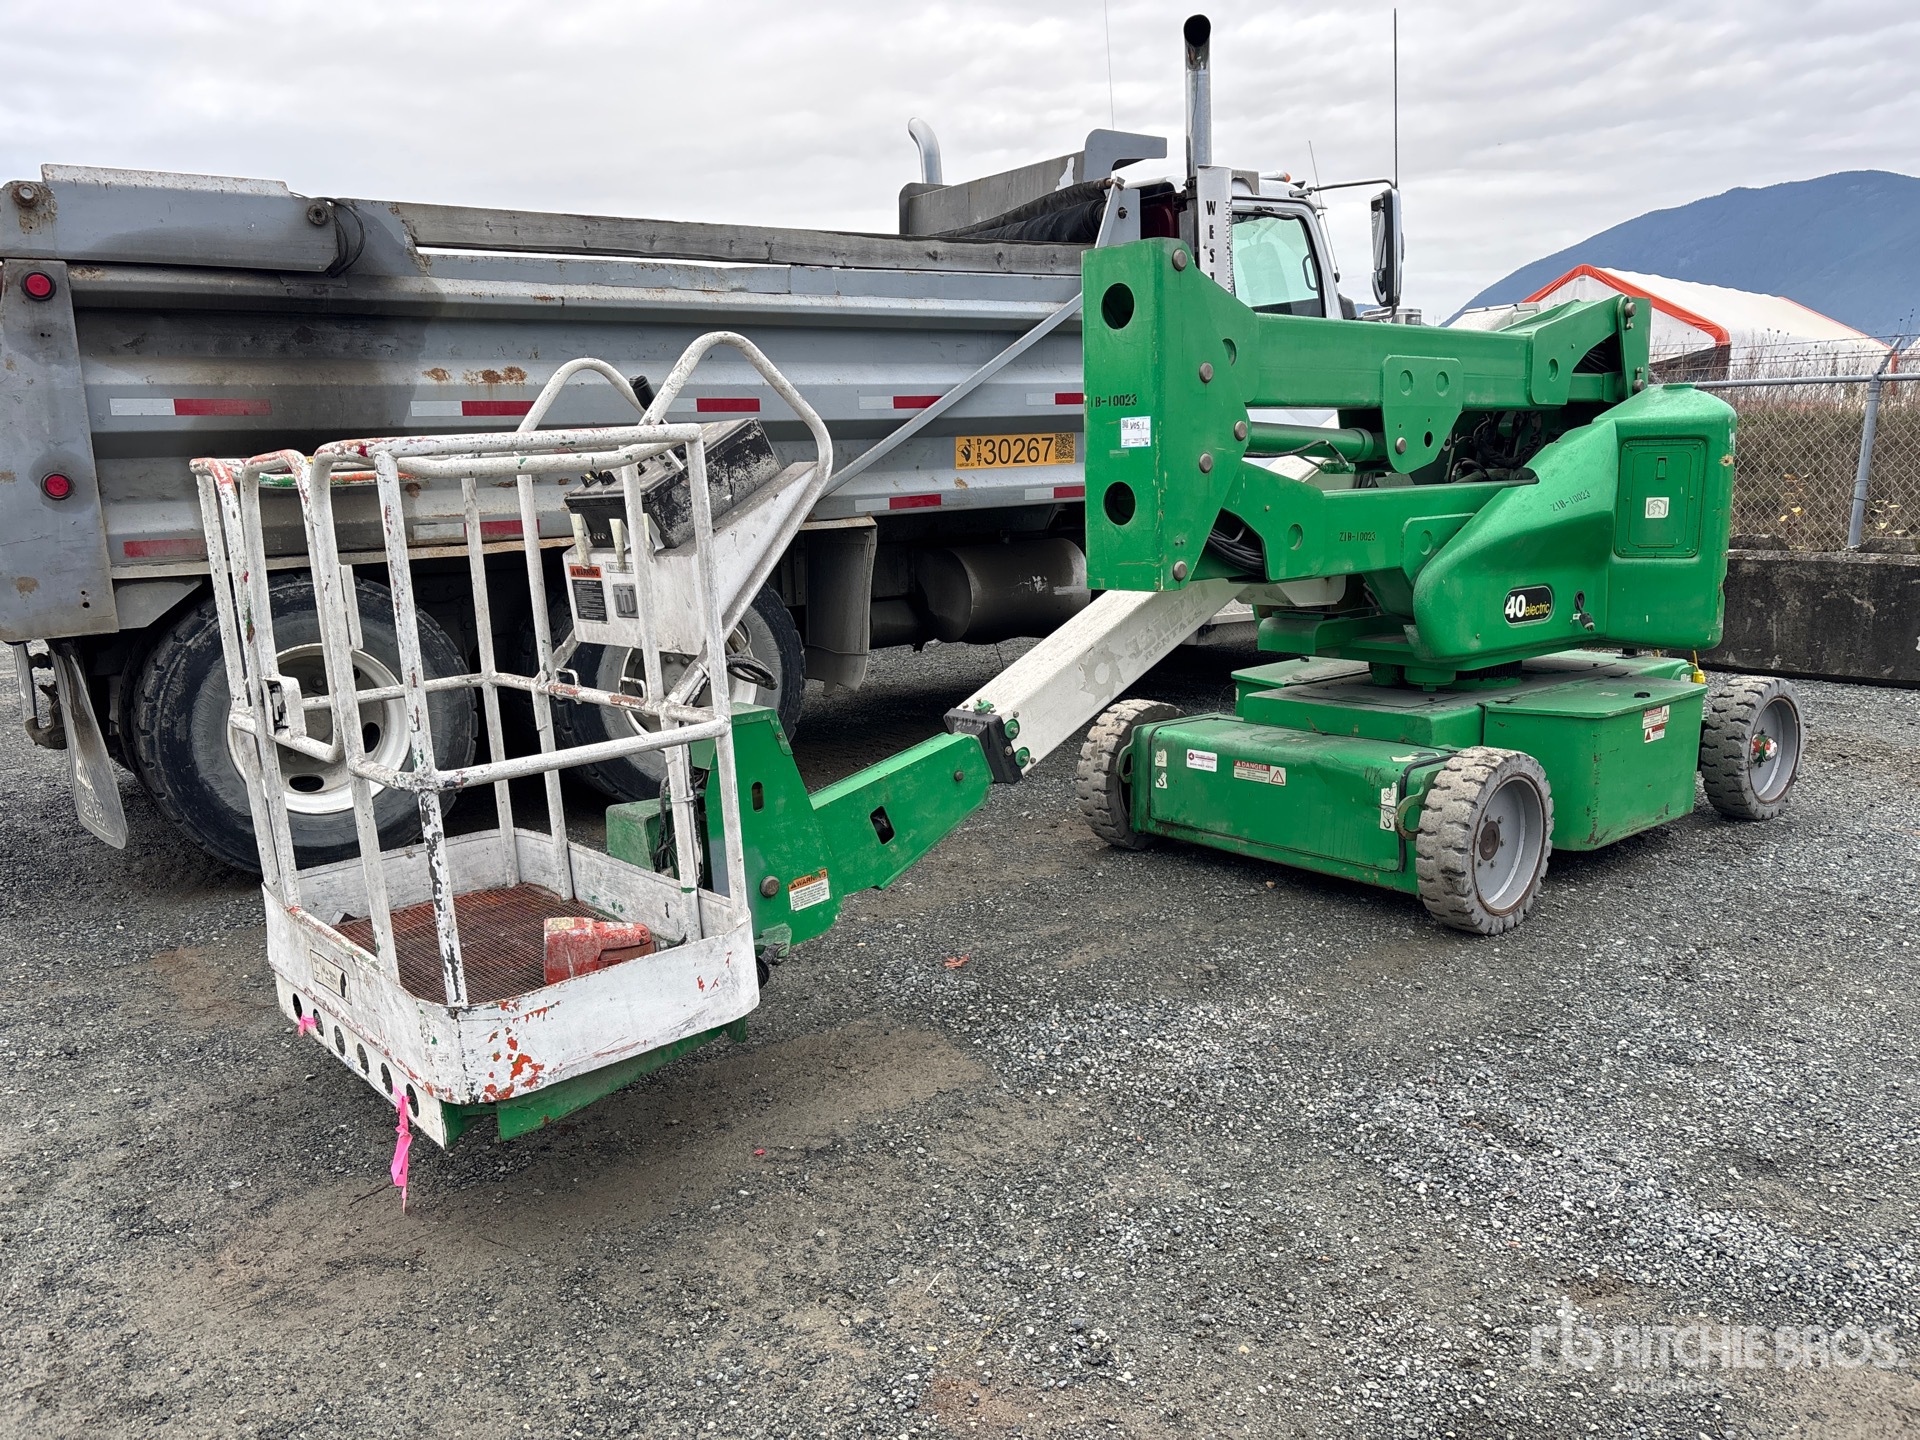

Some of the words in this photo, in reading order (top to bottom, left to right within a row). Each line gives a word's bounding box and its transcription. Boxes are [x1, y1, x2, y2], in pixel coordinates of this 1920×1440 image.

[983, 437, 1054, 465] 30267
[1505, 594, 1526, 619] 40
[1525, 601, 1551, 617] electric
[1242, 761, 1268, 772] DANGER
[796, 871, 827, 886] WARNG
